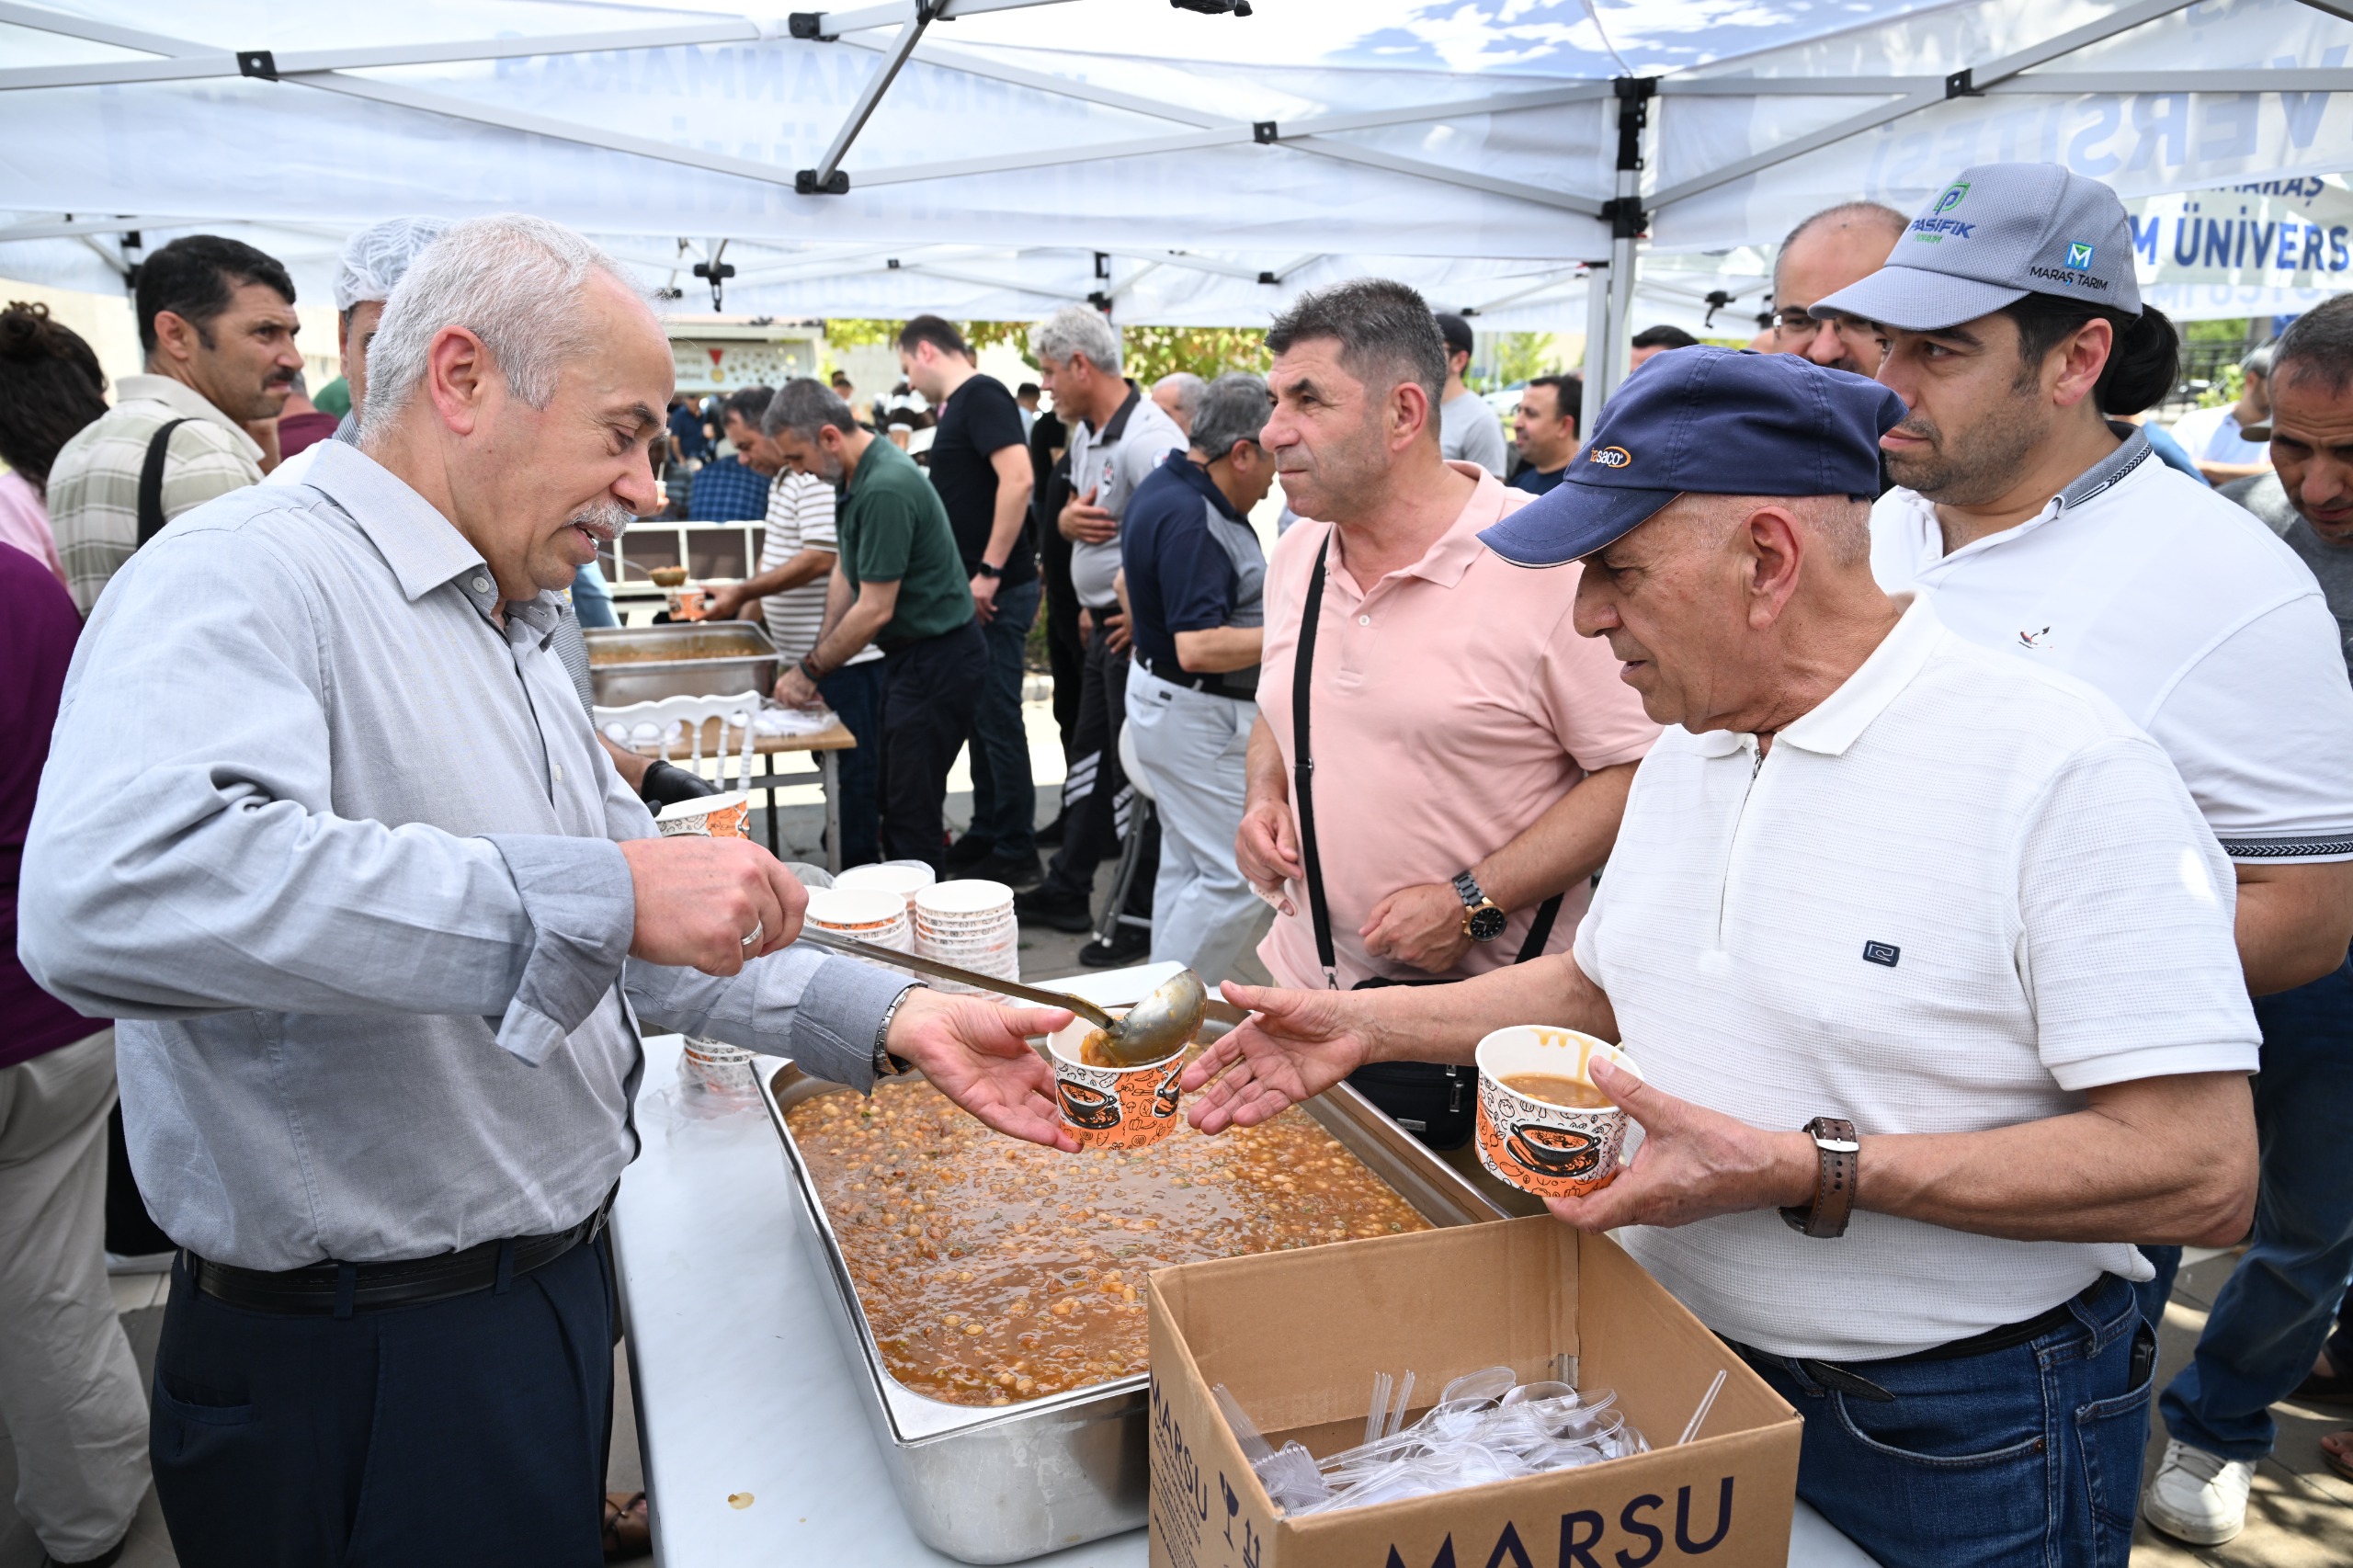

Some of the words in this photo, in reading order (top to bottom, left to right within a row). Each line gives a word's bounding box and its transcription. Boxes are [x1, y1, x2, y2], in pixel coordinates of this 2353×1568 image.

[2029, 266, 2075, 286] MARAŞ
[2077, 273, 2109, 290] TARIM
[1150, 1367, 1207, 1521] MARSU
